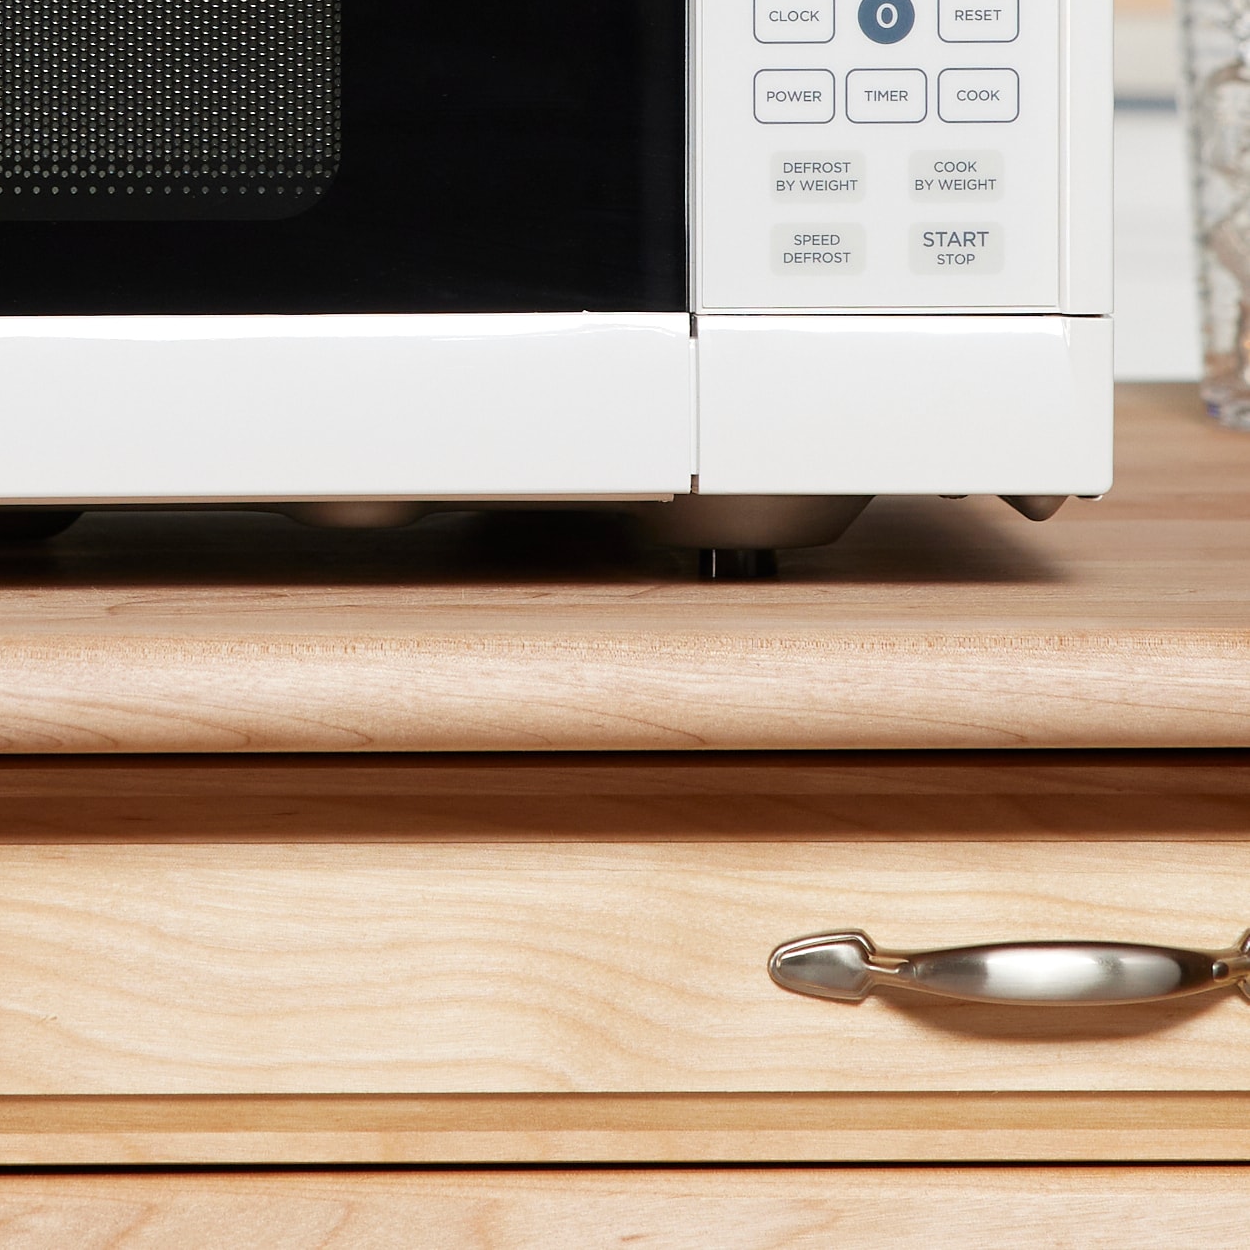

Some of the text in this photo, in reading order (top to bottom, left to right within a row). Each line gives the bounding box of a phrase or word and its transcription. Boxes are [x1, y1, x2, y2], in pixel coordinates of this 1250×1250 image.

[769, 10, 819, 22] CLOCK
[876, 3, 898, 28] 0
[955, 10, 1001, 21] RESET
[767, 91, 822, 102] POWER
[864, 91, 908, 101] TIMER
[956, 90, 1000, 101] COOK
[783, 162, 851, 174] DEFROST
[934, 161, 977, 173] COOK
[776, 180, 858, 191] BY WEIGHT
[915, 179, 996, 190] BY WEIGHT
[794, 235, 840, 246] SPEED
[923, 231, 989, 247] START
[783, 252, 851, 263] DEFROST
[937, 254, 975, 265] STOP
